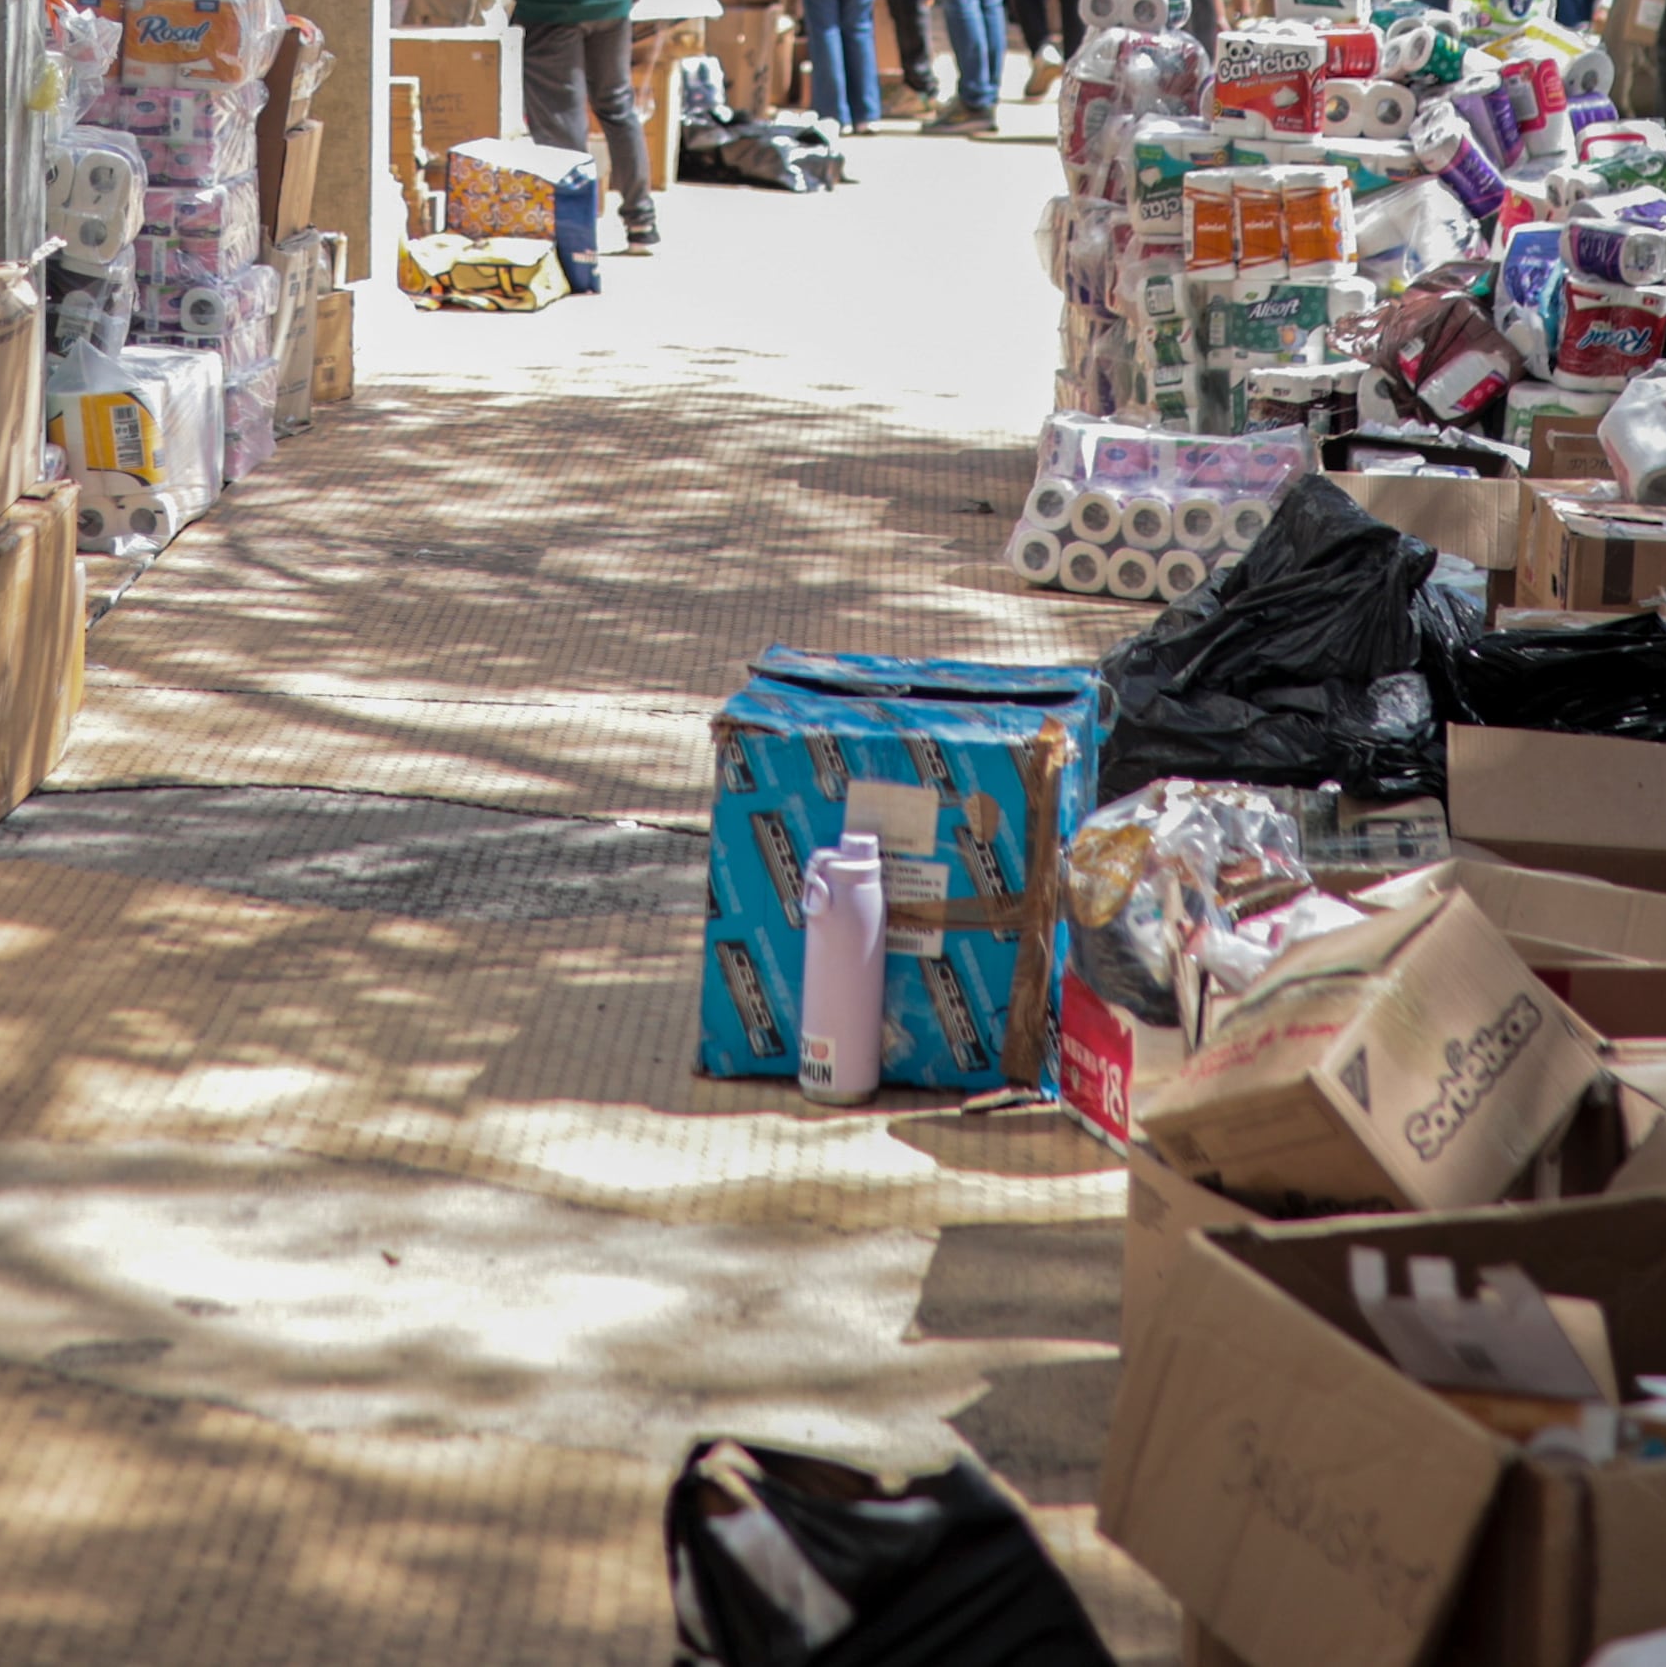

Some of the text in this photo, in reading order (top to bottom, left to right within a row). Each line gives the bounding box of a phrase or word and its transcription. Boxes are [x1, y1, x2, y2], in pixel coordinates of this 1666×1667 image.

[136, 14, 212, 45] Rosal
[1218, 49, 1312, 84] Caricias
[1248, 298, 1300, 319] Alisoft
[1575, 327, 1653, 356] Rosal
